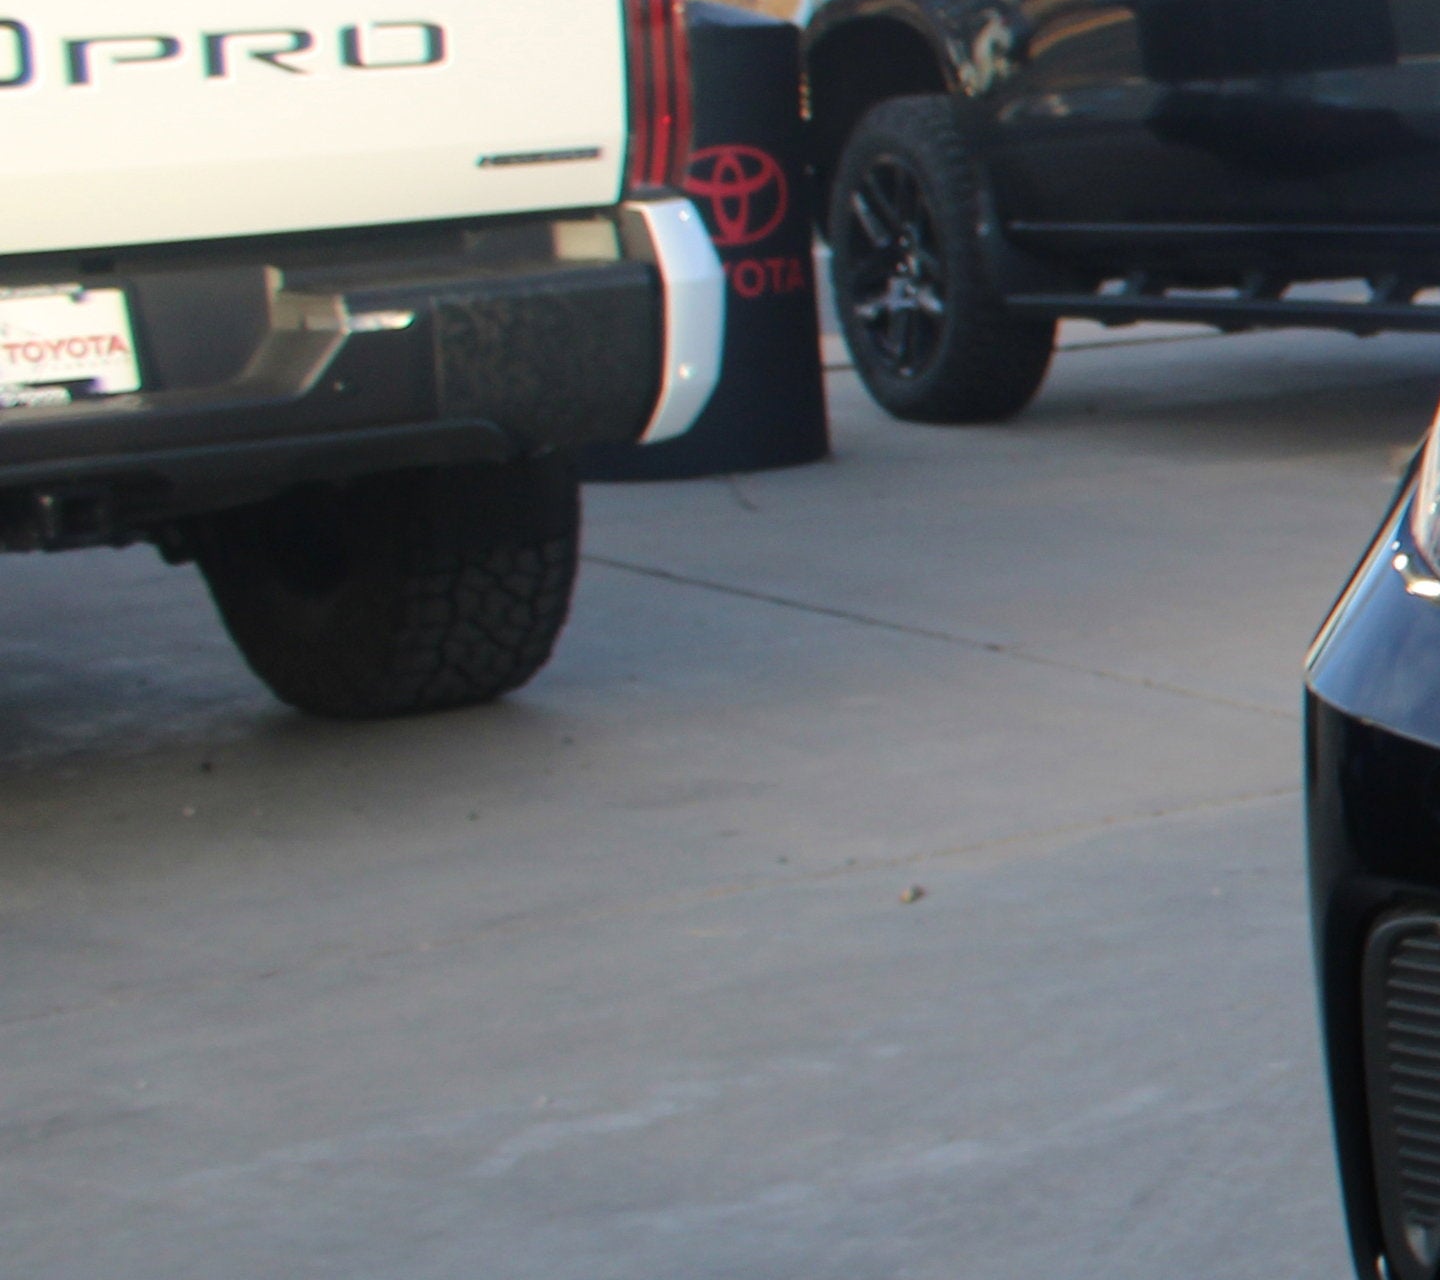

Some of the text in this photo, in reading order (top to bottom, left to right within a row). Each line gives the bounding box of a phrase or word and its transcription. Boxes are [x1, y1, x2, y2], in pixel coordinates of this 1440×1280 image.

[62, 21, 448, 87] PRO
[722, 257, 806, 298] OTA
[2, 335, 129, 364] TOYOTA
